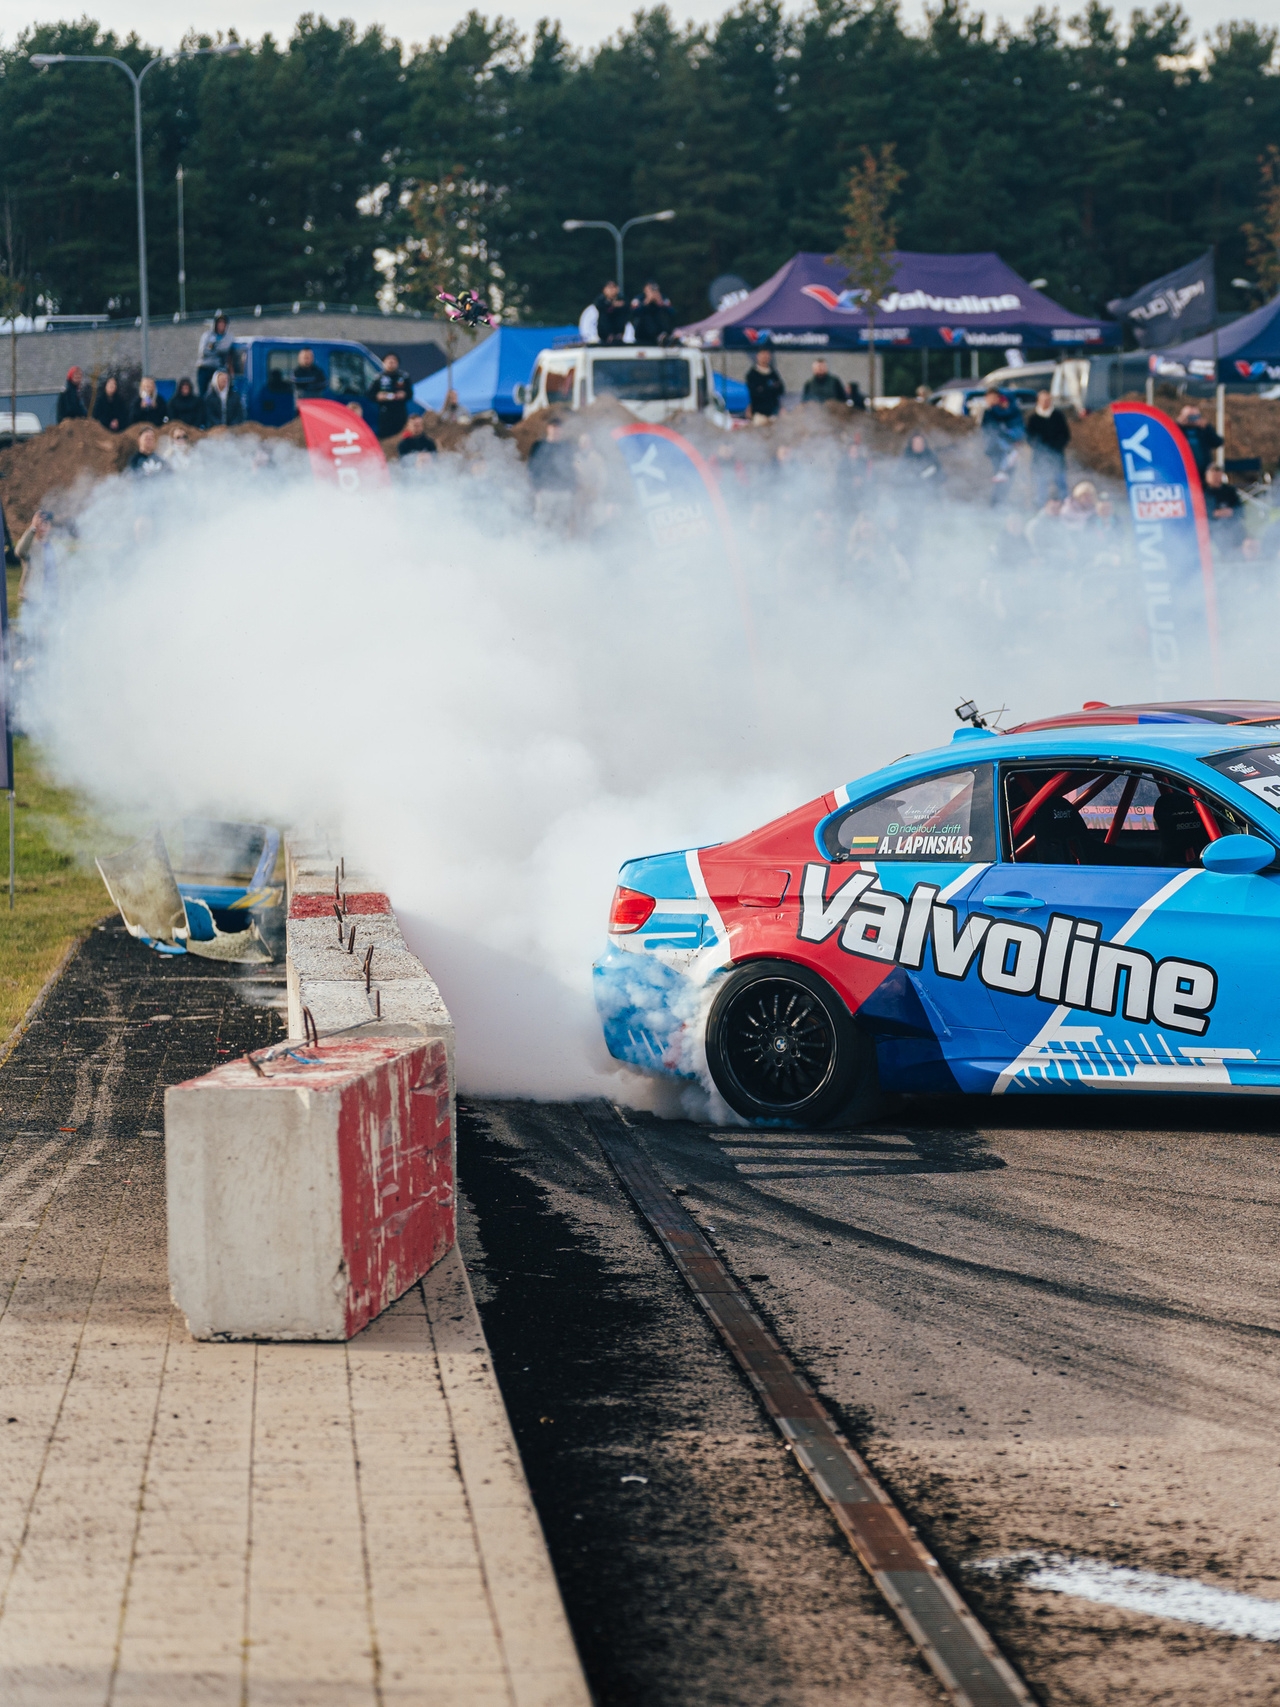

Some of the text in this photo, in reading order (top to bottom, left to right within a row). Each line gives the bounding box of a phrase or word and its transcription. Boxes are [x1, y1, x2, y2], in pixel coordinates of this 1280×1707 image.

[877, 289, 1021, 314] Valvoline
[878, 835, 973, 854] A. LAPINSKAS
[798, 862, 1217, 1037] Valvoline
